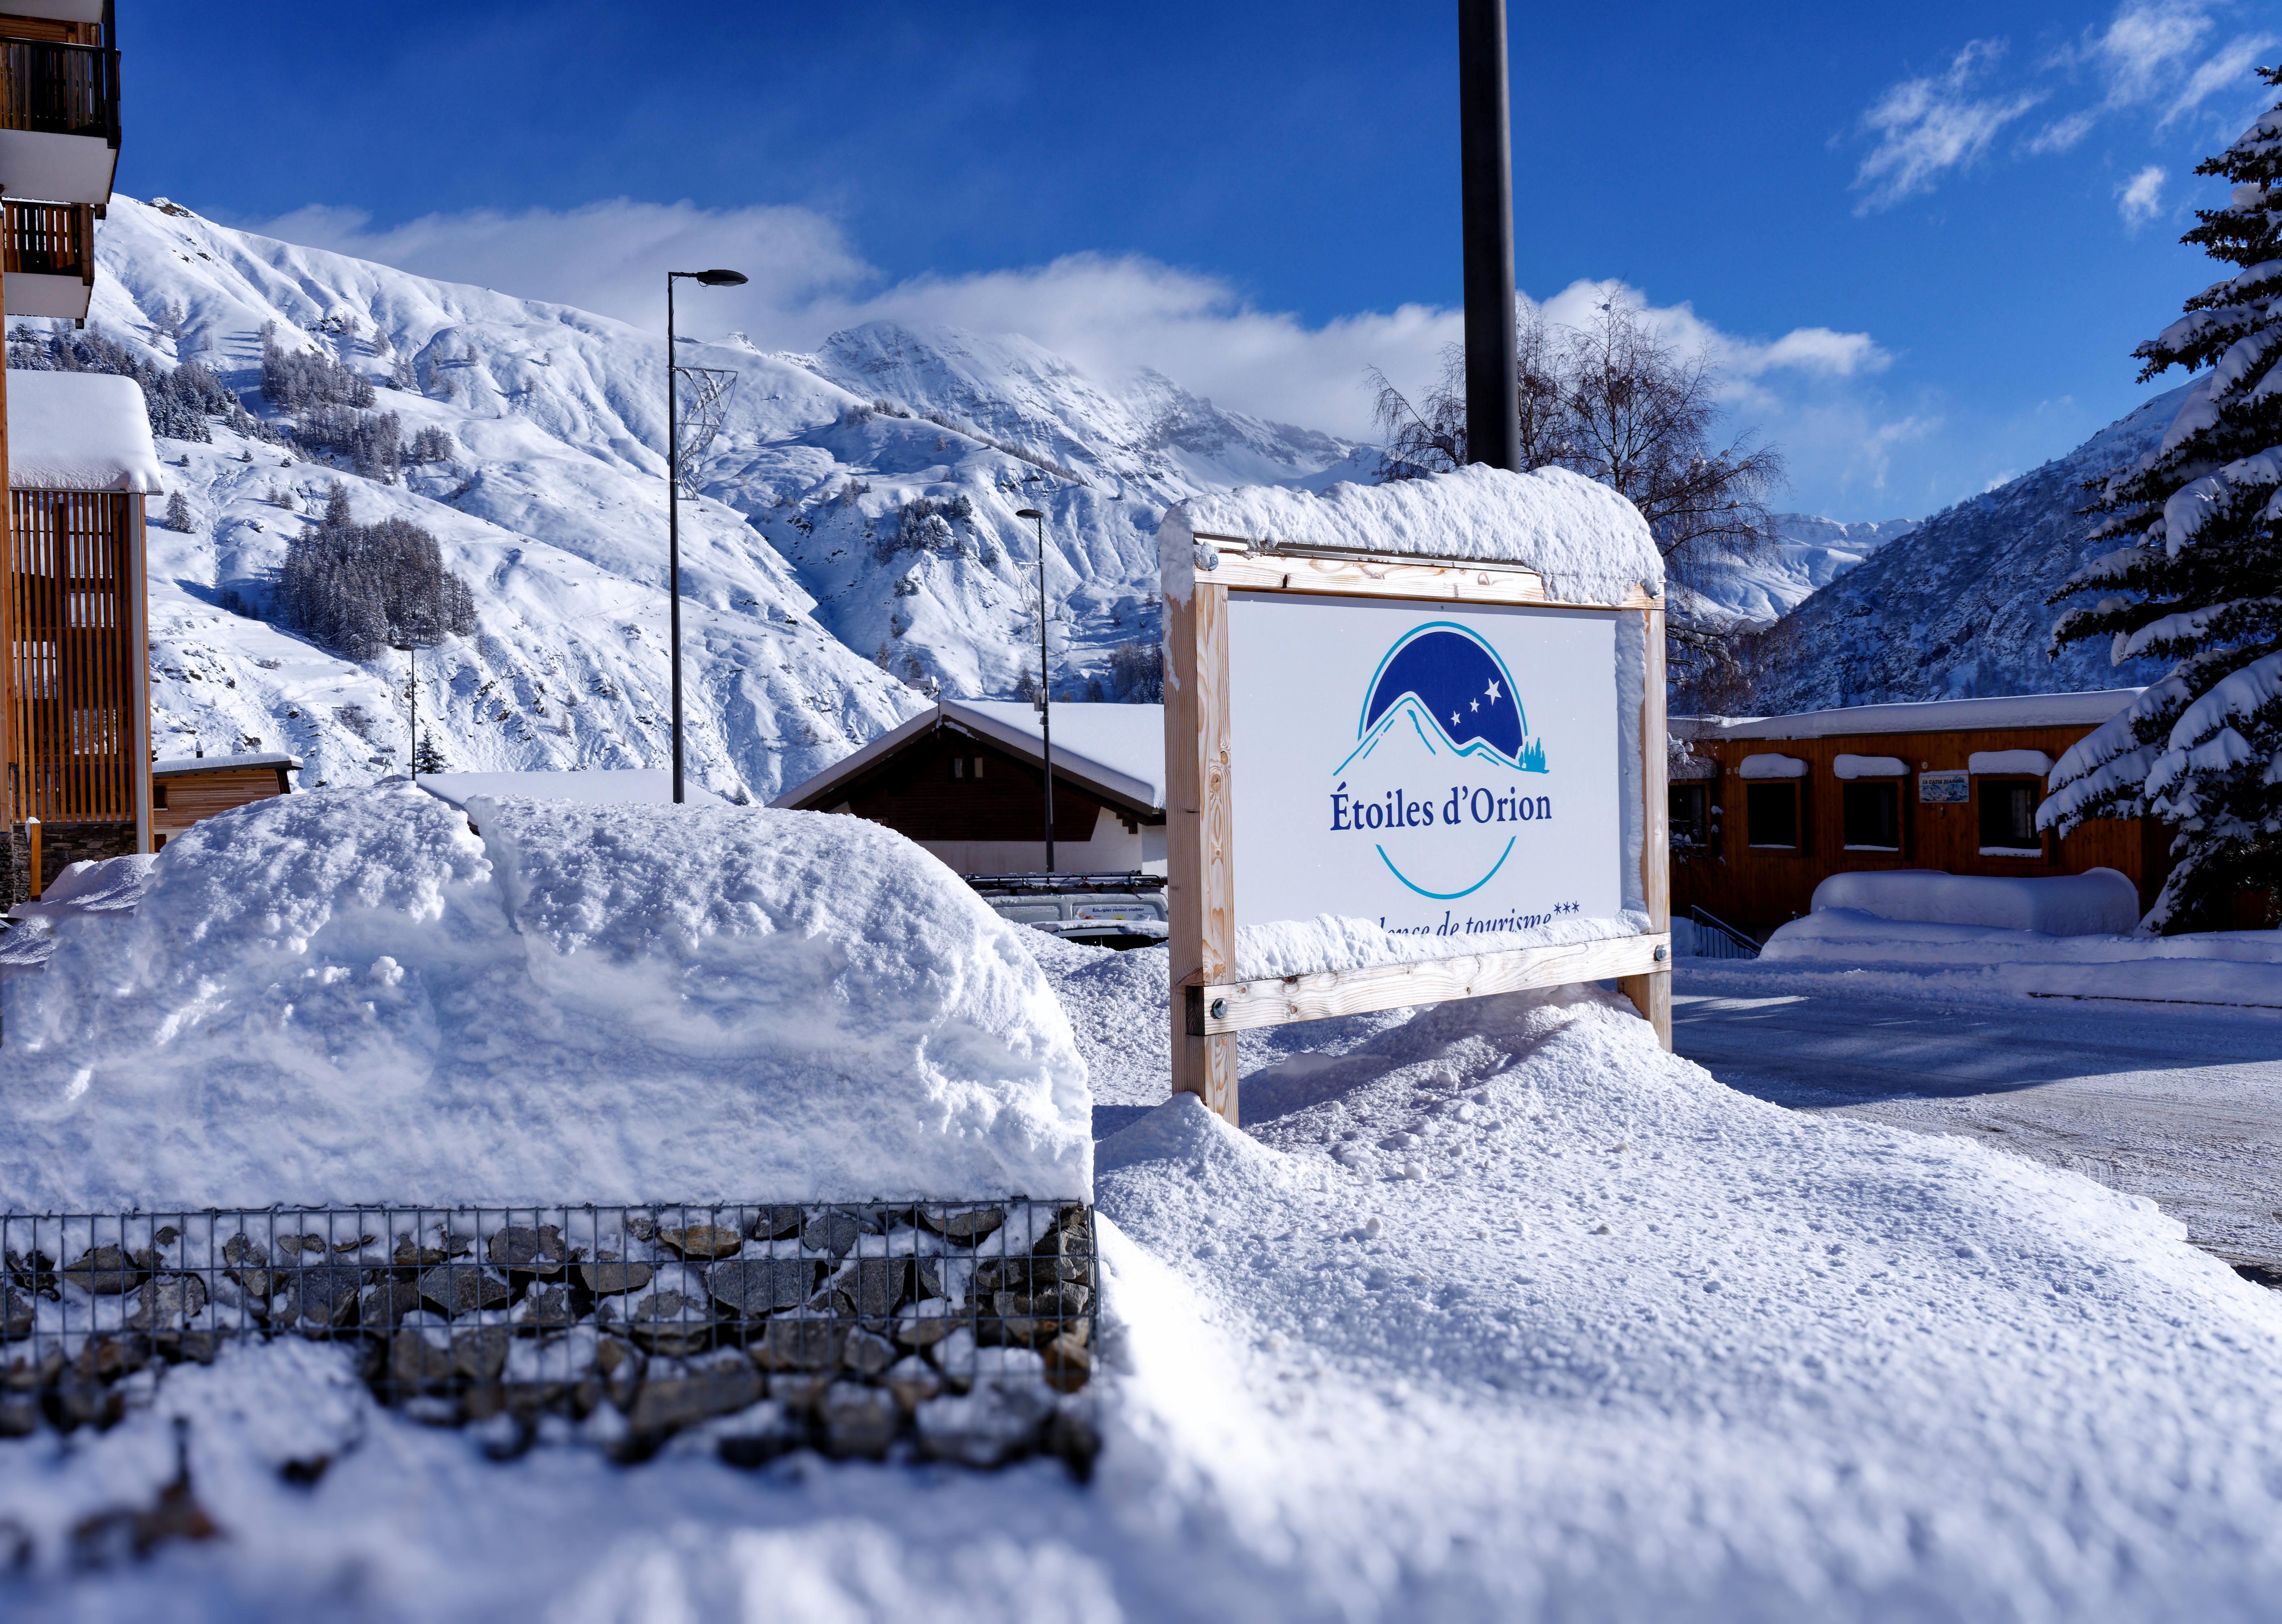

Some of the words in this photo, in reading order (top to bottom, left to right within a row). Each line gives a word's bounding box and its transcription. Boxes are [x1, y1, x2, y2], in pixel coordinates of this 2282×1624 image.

[1330, 782, 1434, 831] Étoiles
[1443, 786, 1552, 825] d'Orion
[1436, 911, 1459, 935] de
